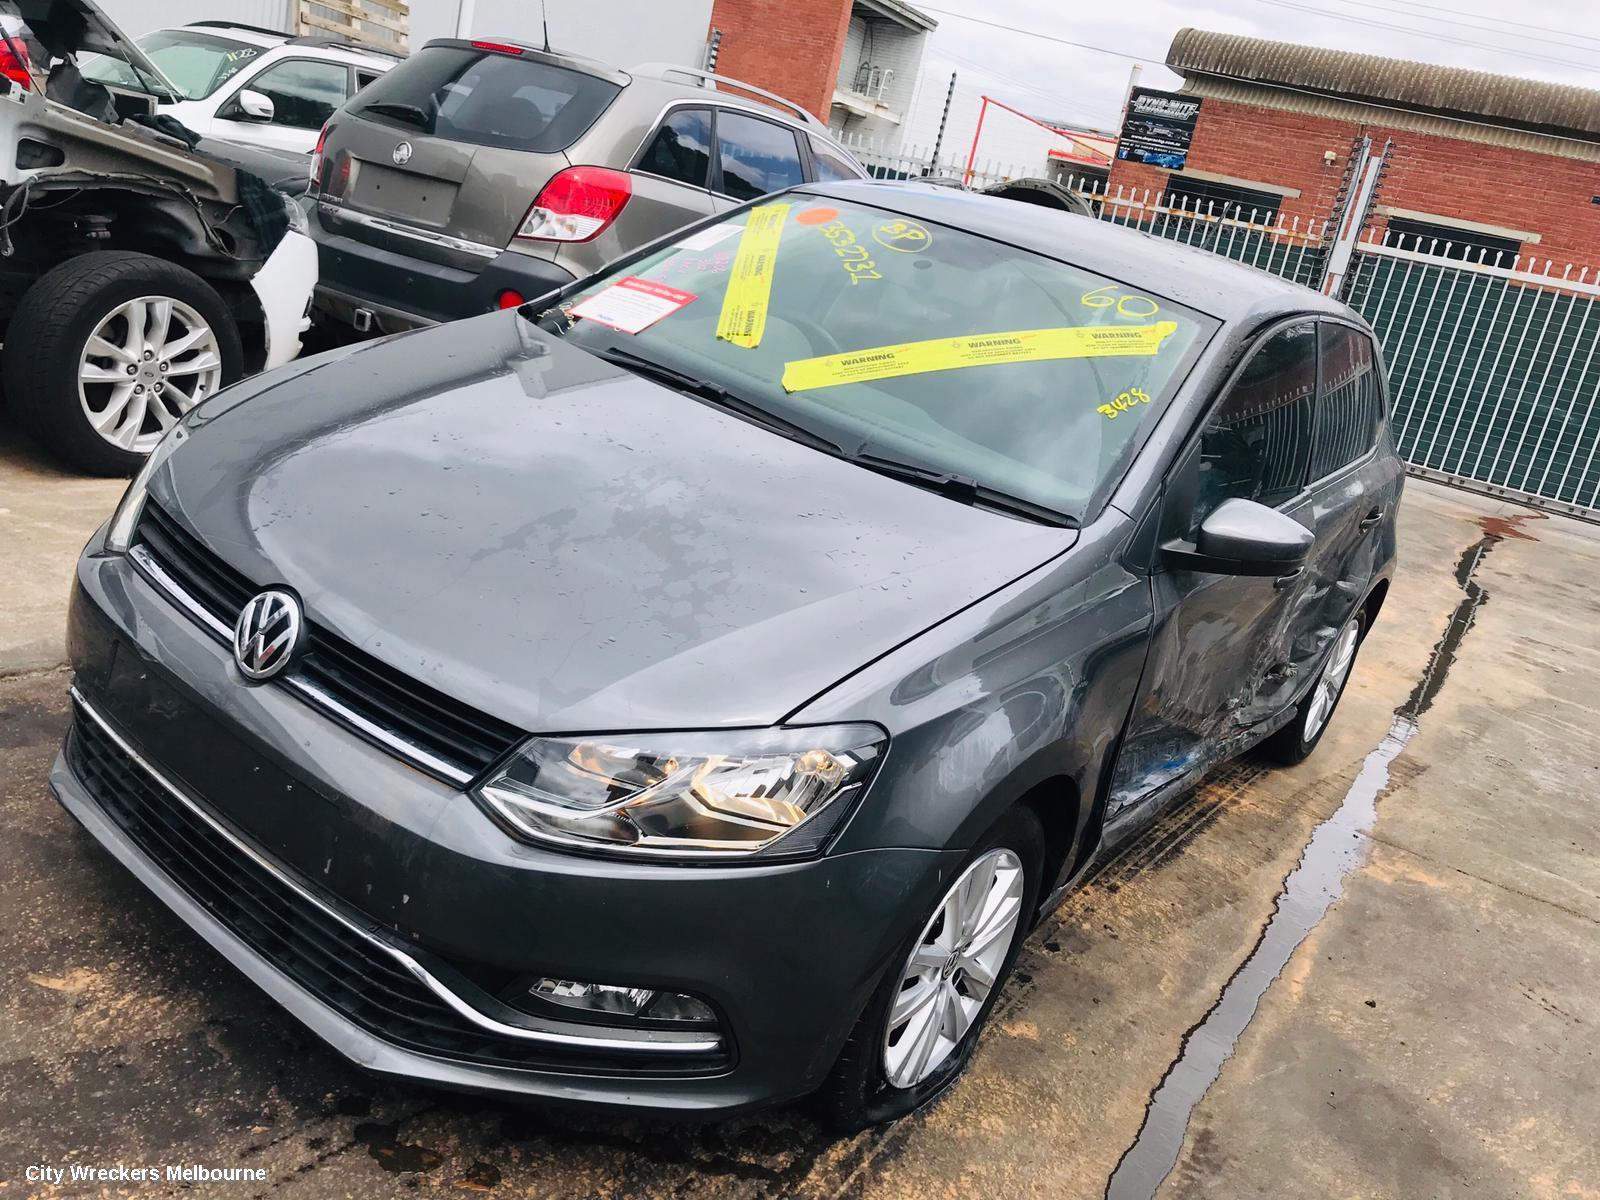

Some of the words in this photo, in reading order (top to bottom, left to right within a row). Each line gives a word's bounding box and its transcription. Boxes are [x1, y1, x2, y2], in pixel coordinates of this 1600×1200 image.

[1081, 285, 1158, 317] 60
[1091, 332, 1142, 340] WARNING
[967, 337, 1021, 349] WARNING
[840, 353, 896, 367] WARNING
